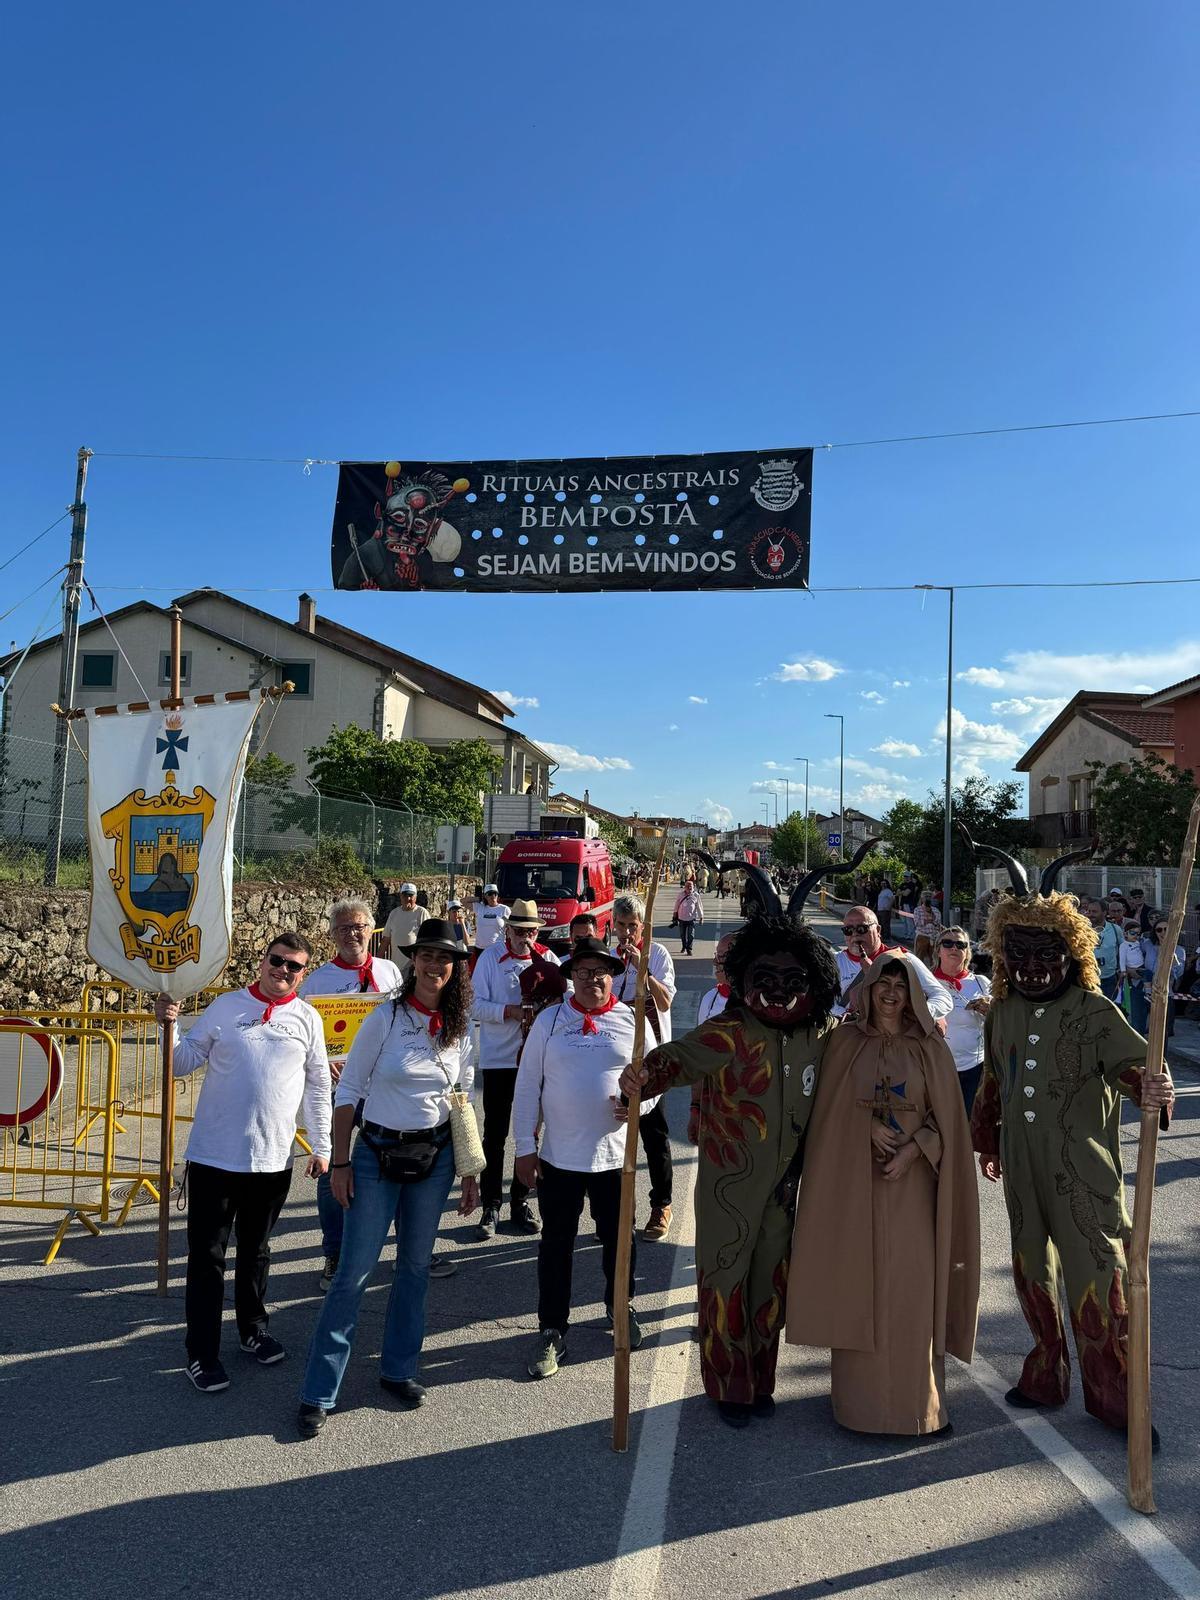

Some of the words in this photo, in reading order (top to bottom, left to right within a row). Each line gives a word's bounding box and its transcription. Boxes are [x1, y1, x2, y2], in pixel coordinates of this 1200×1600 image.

[481, 474, 579, 492] RITUAIS
[586, 468, 740, 492] ANCESTRAIS
[519, 502, 699, 528] BEMPOSTA
[477, 553, 561, 576] SEJAM
[569, 550, 737, 574] BEM-VINDOS
[829, 836, 841, 844] 30
[333, 1008, 367, 1016] CAPDEPERA
